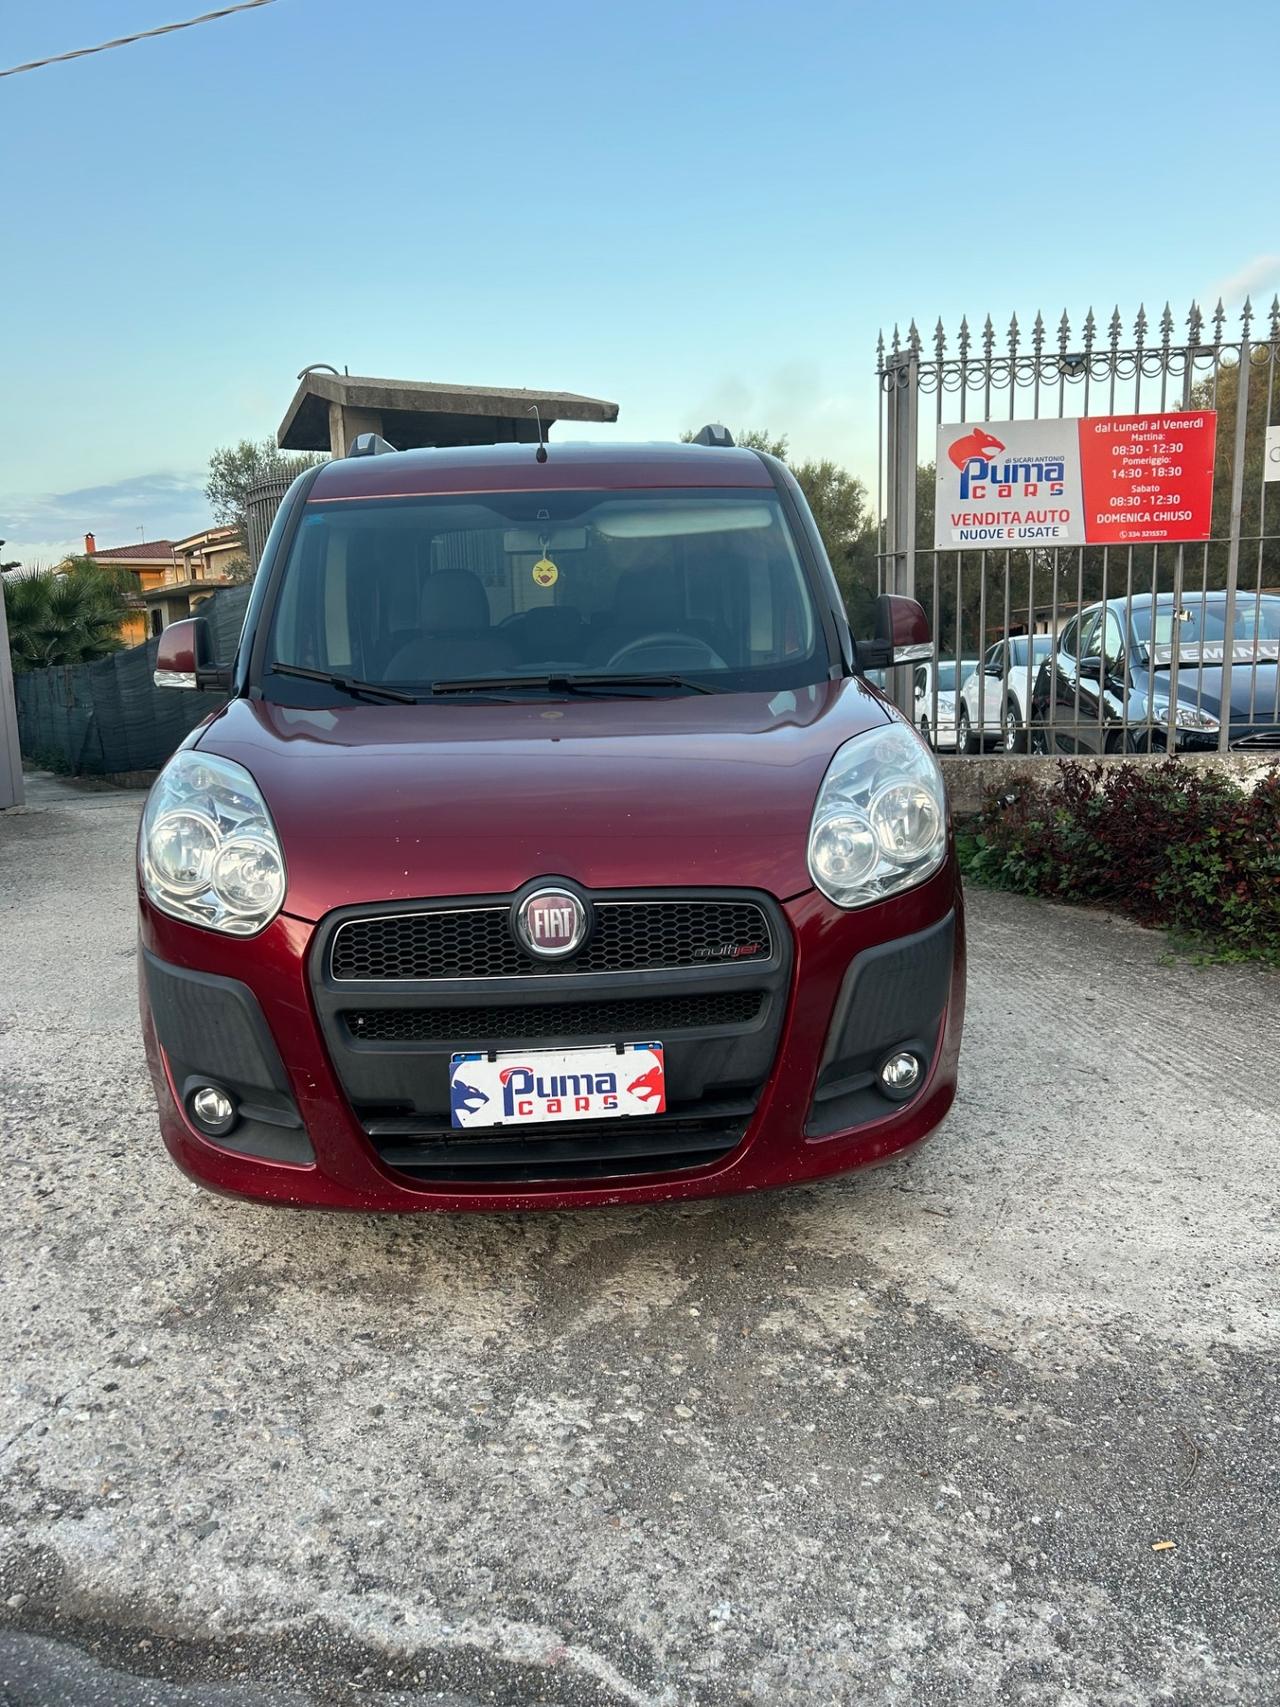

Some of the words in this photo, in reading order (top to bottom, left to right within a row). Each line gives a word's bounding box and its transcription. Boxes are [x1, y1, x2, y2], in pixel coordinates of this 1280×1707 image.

[1095, 423, 1110, 433] dal
[1150, 420, 1160, 430] al
[1131, 433, 1166, 441] Mattina:
[1112, 445, 1143, 456] 08:30
[1153, 443, 1184, 453] 12:30
[1122, 456, 1171, 466] Pomeriggio:
[960, 457, 1064, 499] Puma
[1112, 468, 1142, 479] 14:30
[1152, 467, 1182, 477] 18:30
[1131, 484, 1160, 493] Sabato
[1109, 496, 1140, 507] 08:30
[1150, 495, 1180, 505] 12:30
[951, 511, 1021, 526] VENDITA
[1024, 509, 1071, 523] AUTO
[1096, 512, 1151, 523] DOMENICA
[1153, 510, 1192, 521] CHIUSO
[960, 528, 1004, 540] NUOVE
[1007, 528, 1015, 538] E
[1018, 526, 1060, 538] USATE
[534, 907, 572, 938] FIAT
[502, 1069, 617, 1116] Puma
